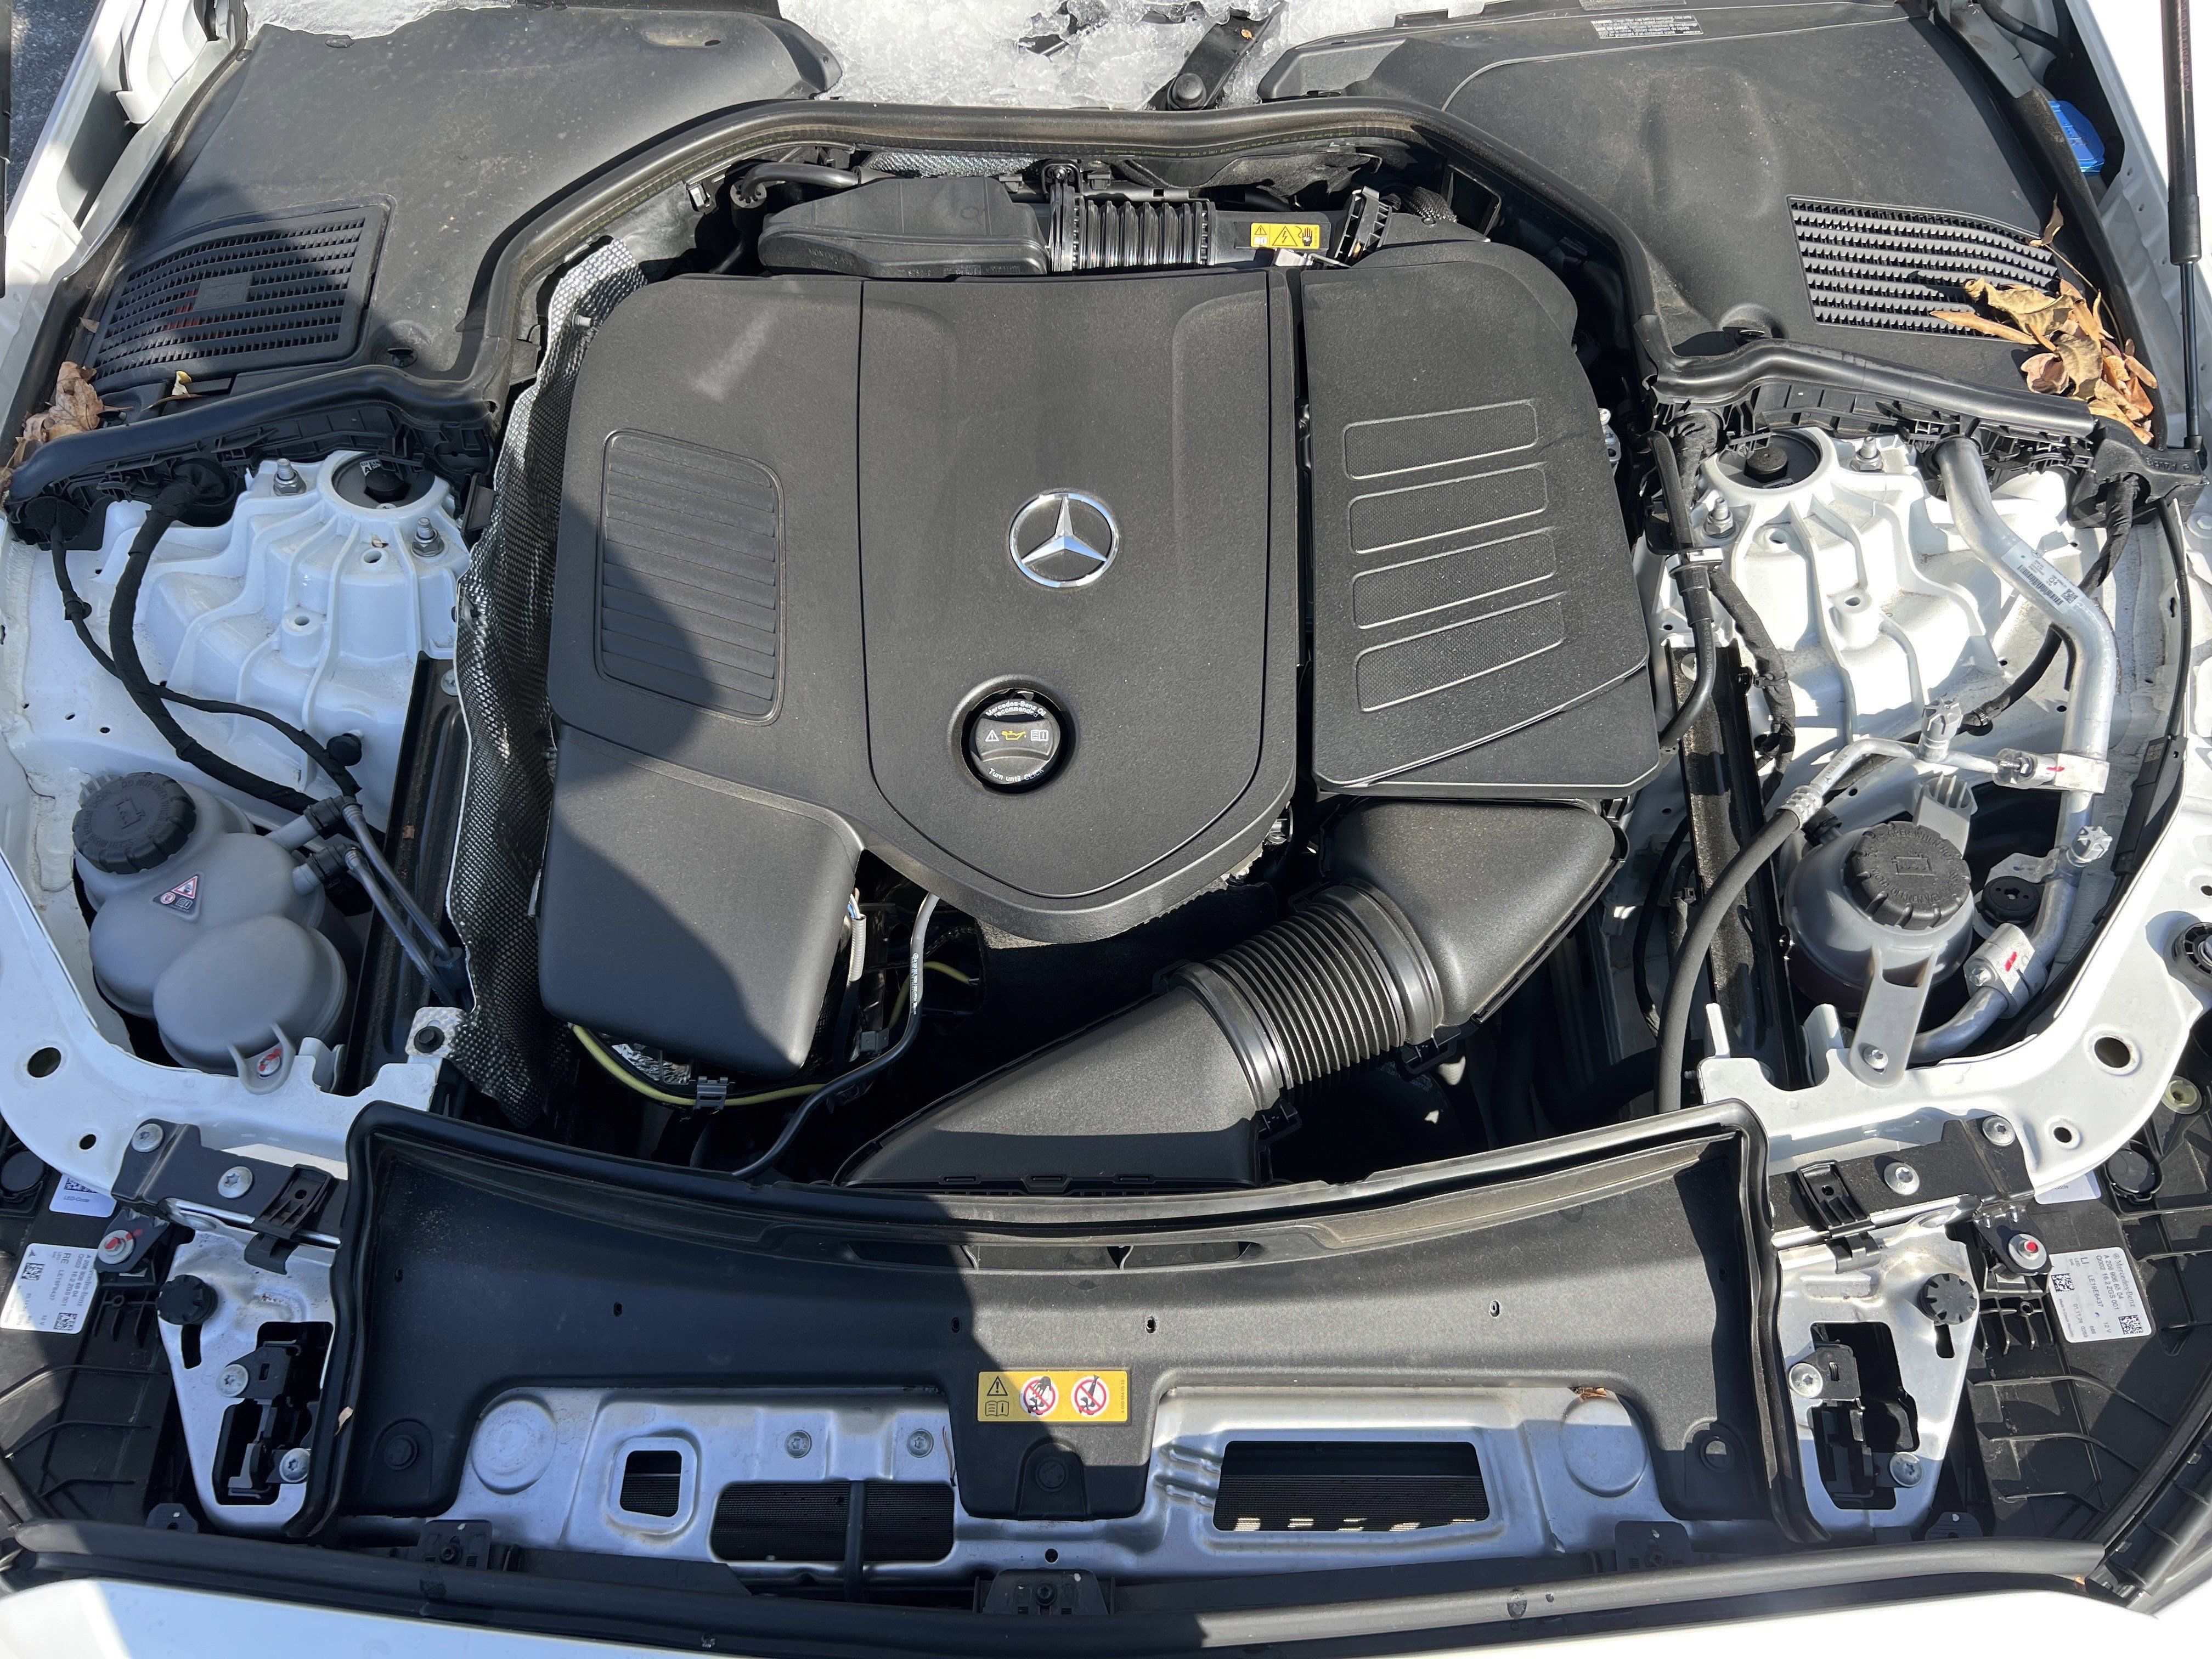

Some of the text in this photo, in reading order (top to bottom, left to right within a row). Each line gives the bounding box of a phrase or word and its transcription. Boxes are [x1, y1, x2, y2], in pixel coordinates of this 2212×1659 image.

[985, 701, 1047, 717] Mercedes-Benz Oil
[994, 706, 1039, 718] recommended
[989, 768, 1003, 781] Turn
[1024, 768, 1045, 781] CLICK
[60, 1253, 72, 1264] RE
[2116, 1260, 2136, 1308] Mercedes-Benz
